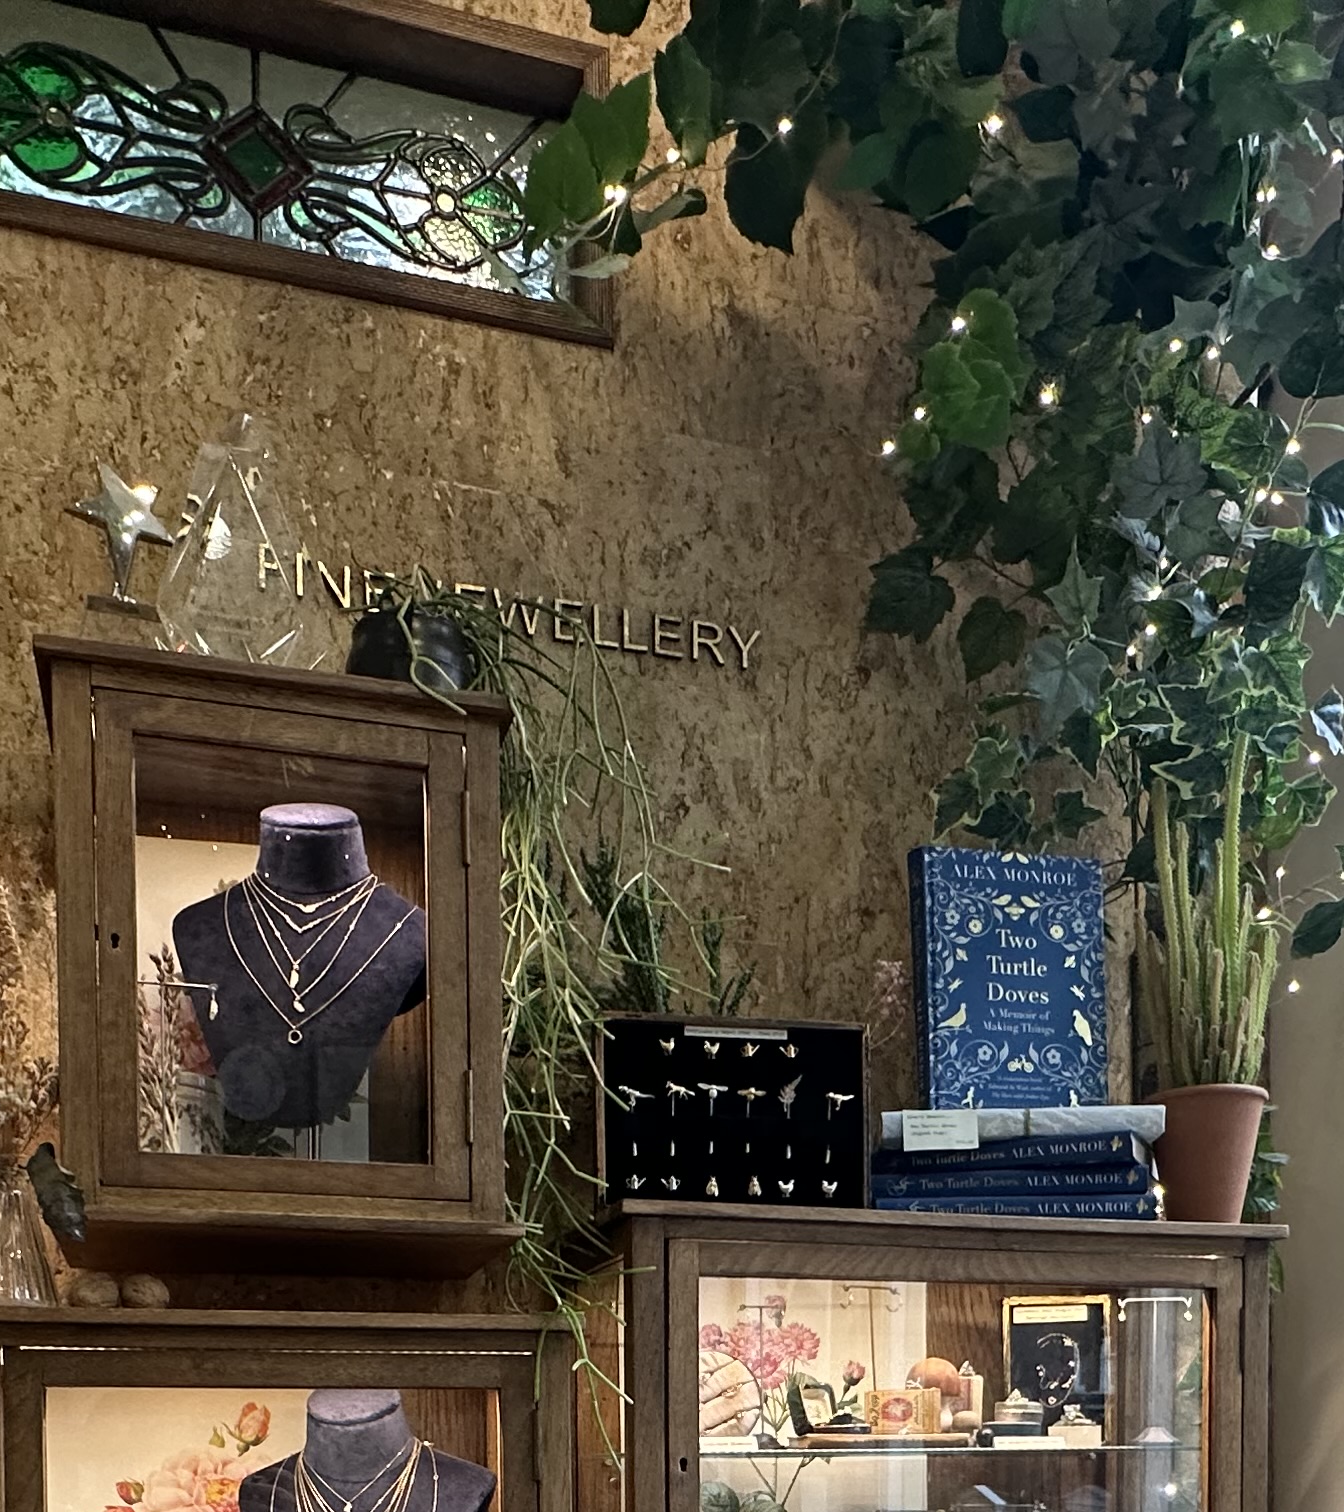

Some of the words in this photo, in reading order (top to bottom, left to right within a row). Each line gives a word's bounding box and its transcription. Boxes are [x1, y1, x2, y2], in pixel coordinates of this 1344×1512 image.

[951, 864, 996, 881] ALEX
[1003, 867, 1078, 887] MONROE
[995, 928, 1038, 950] Two
[986, 954, 1048, 978] Turtle
[986, 981, 1050, 1005] Doves
[989, 1007, 995, 1018] A
[999, 1007, 1037, 1020] Memoir
[1039, 1010, 1052, 1021] of
[983, 1021, 1019, 1035] Making
[1021, 1023, 1055, 1037] Things
[911, 1156, 932, 1167] Two
[936, 1154, 966, 1165] Turtle
[970, 1151, 1005, 1162] Doves
[1012, 1145, 1045, 1159] ALEX
[1049, 1140, 1107, 1155] MONROE
[919, 1179, 943, 1191] Two
[946, 1177, 979, 1190] Turtle
[983, 1176, 1019, 1188] Doves
[1026, 1175, 1060, 1187] ALEX
[1064, 1172, 1122, 1185] MONROE
[930, 1204, 954, 1214] Two
[957, 1203, 991, 1214] Turtle
[994, 1203, 1030, 1214] Doves
[1037, 1202, 1071, 1214] ALEX
[1075, 1201, 1133, 1213] MONROE
